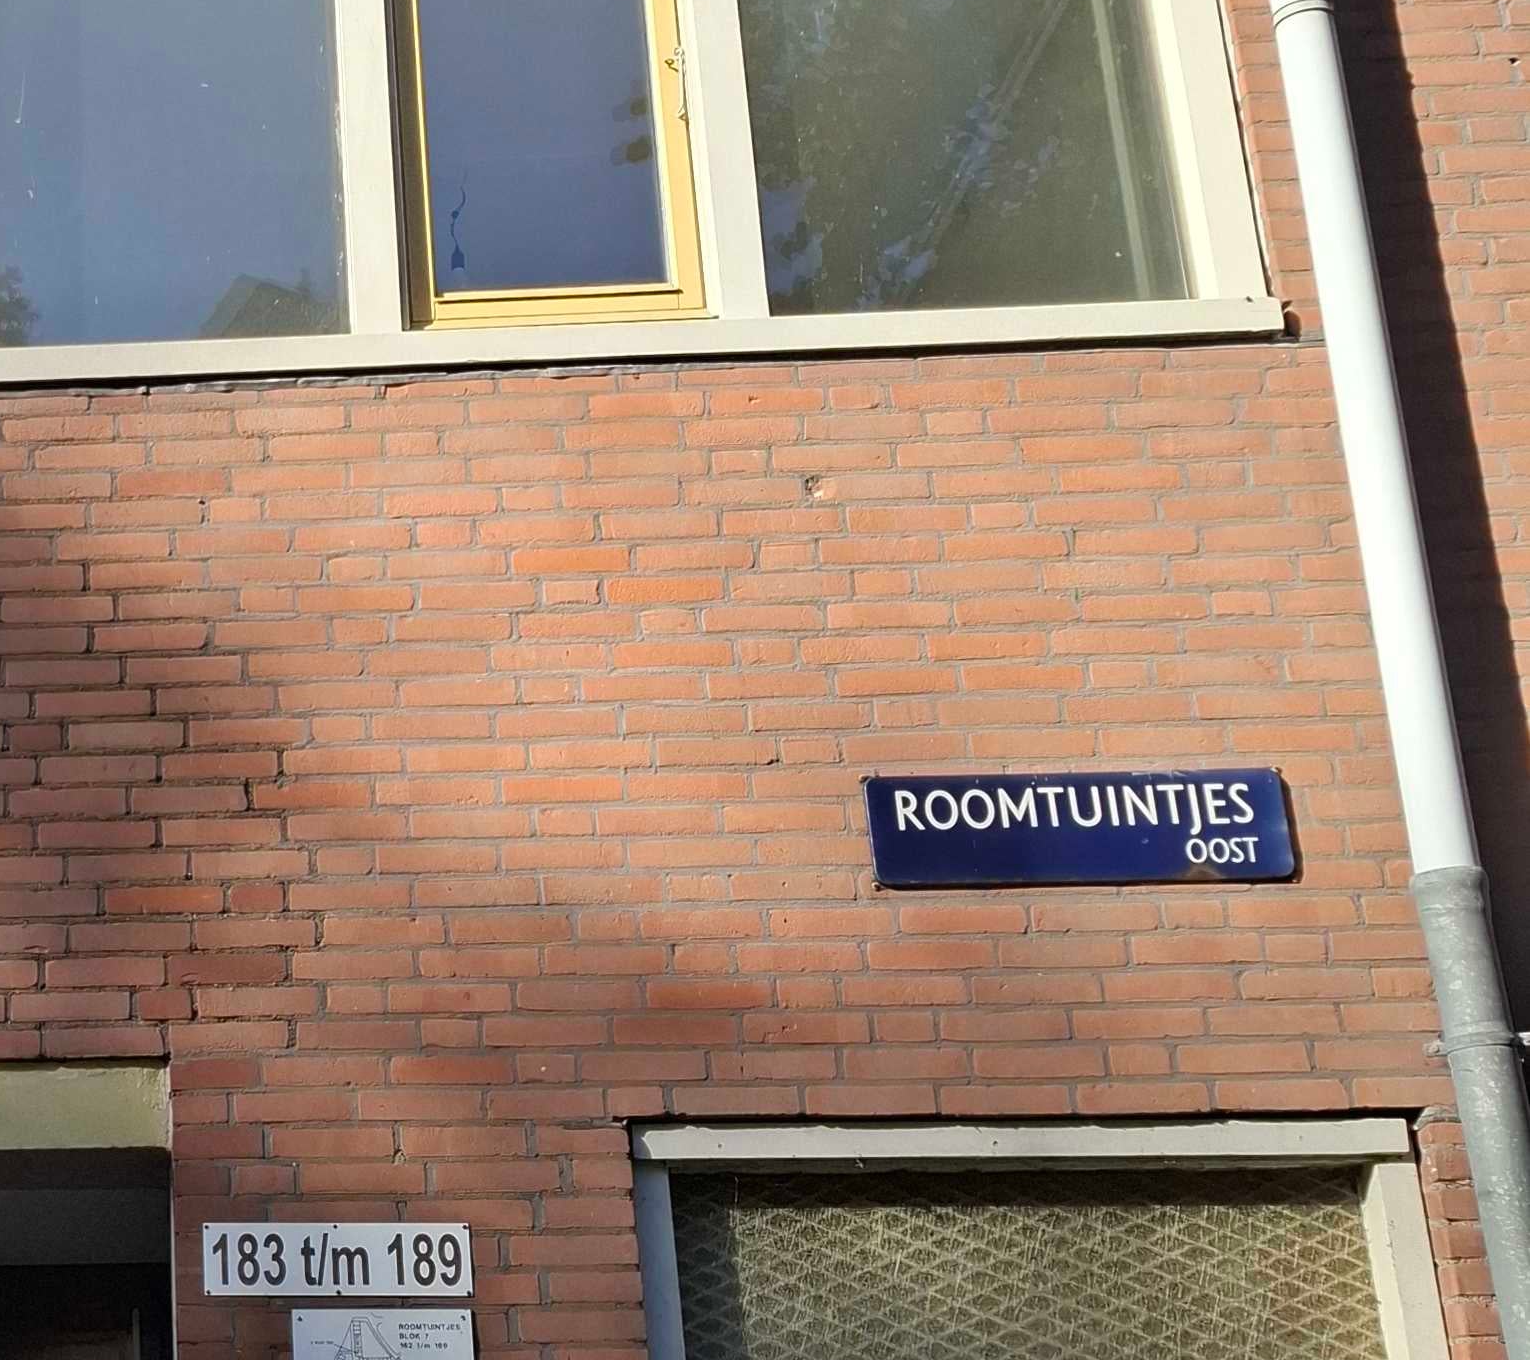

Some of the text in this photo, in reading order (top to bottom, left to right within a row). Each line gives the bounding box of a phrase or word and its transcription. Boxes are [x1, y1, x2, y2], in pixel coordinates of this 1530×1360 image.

[893, 782, 1255, 835] ROOMTUINTJES
[1185, 836, 1259, 865] OOST
[211, 1232, 463, 1287] 183 t/m 189
